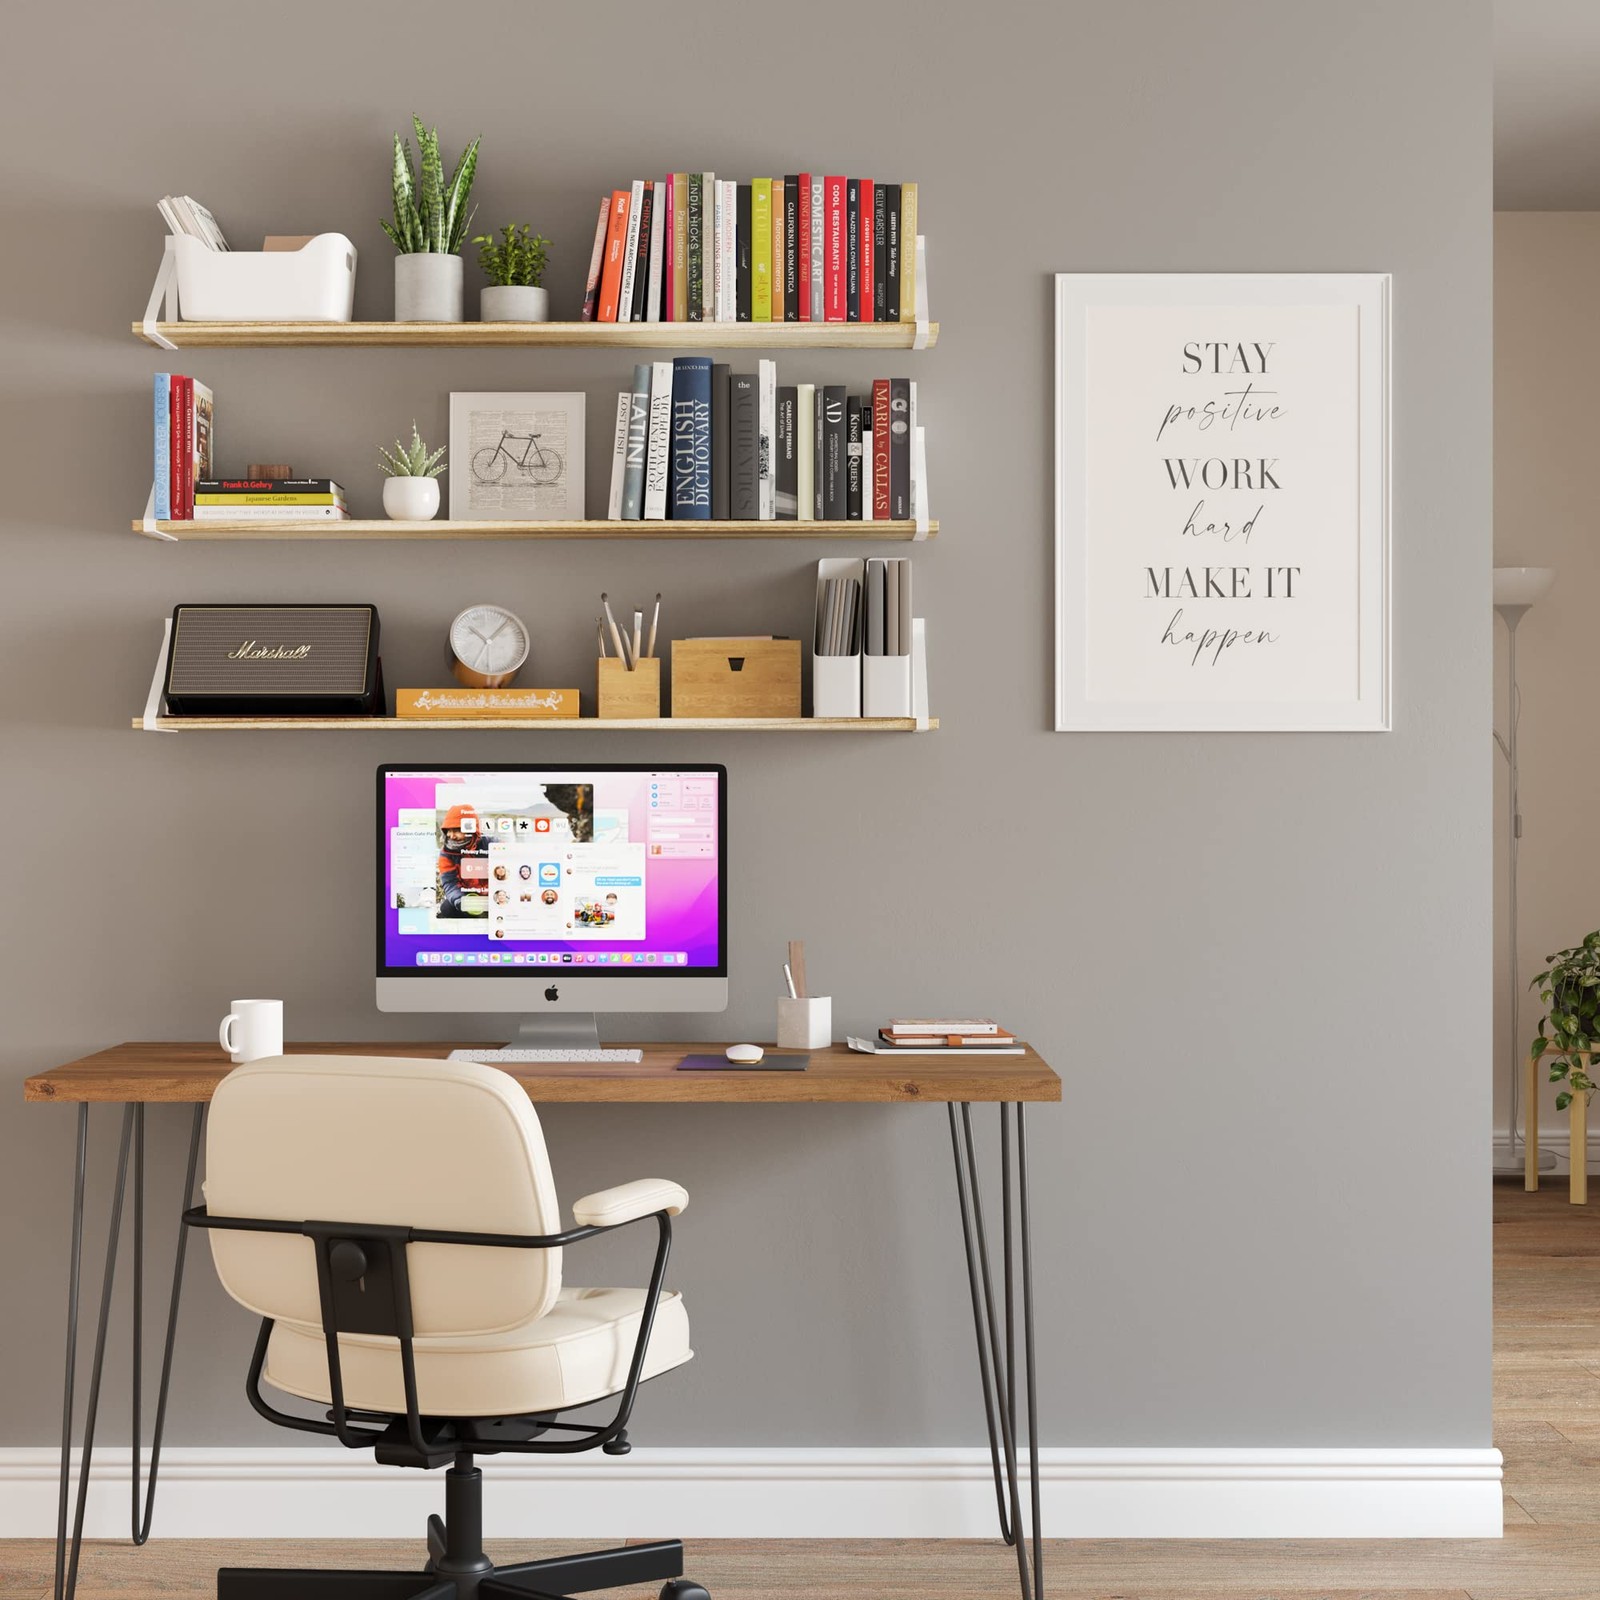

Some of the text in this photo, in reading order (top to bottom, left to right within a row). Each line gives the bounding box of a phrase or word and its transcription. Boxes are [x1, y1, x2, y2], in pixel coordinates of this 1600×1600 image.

[639, 199, 651, 257] CHINA STYLE
[690, 184, 698, 249] INDIA HICKS
[802, 220, 808, 229] IN
[812, 184, 822, 284] DOMESTIC ART
[876, 208, 884, 245] WEARSTLER
[904, 192, 914, 238] REGENCY
[677, 211, 687, 269] Paris Interiors
[625, 248, 634, 288] ARCHITECTURE
[1183, 342, 1276, 374] STAY
[738, 381, 751, 389] the
[616, 396, 628, 455] LOST FISH
[627, 393, 648, 462] LATIN
[649, 395, 661, 452] CENTURY
[826, 397, 842, 423] AD
[851, 414, 859, 441] KINGS
[876, 388, 887, 437] MARIA
[1156, 383, 1287, 442] positive
[656, 394, 670, 492] ENCYCLOPEDIA
[675, 399, 695, 506] ENGLISH
[695, 399, 709, 506] DICTIONARY
[250, 482, 272, 490] Gehry
[848, 456, 859, 492] QUEENS
[876, 453, 887, 509] CALLAS
[1161, 458, 1283, 490] WORK
[1182, 499, 1264, 544] hard
[1143, 566, 1301, 599] MAKE IT
[228, 639, 311, 660] Marshall
[1161, 608, 1280, 666] happen
